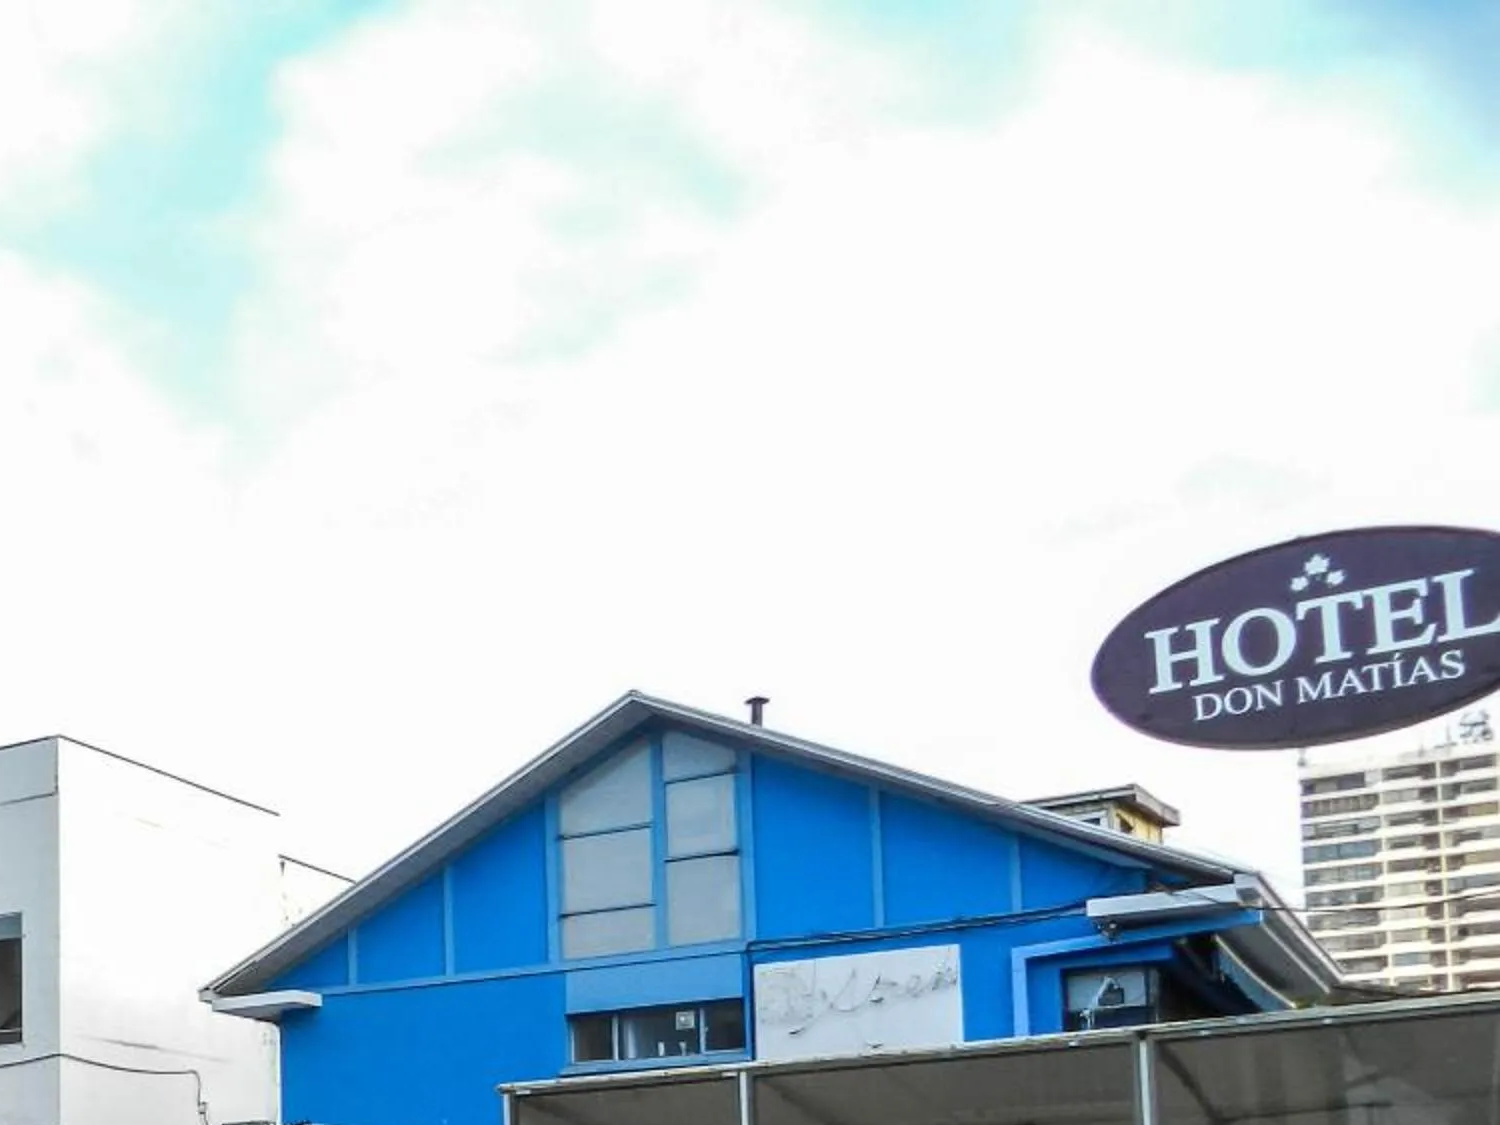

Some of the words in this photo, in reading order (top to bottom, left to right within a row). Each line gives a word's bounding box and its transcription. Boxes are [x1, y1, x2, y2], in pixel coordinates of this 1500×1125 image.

[1144, 568, 1500, 694] HOTEL
[1193, 680, 1283, 722] DON
[1297, 650, 1466, 705] MATÍAS
